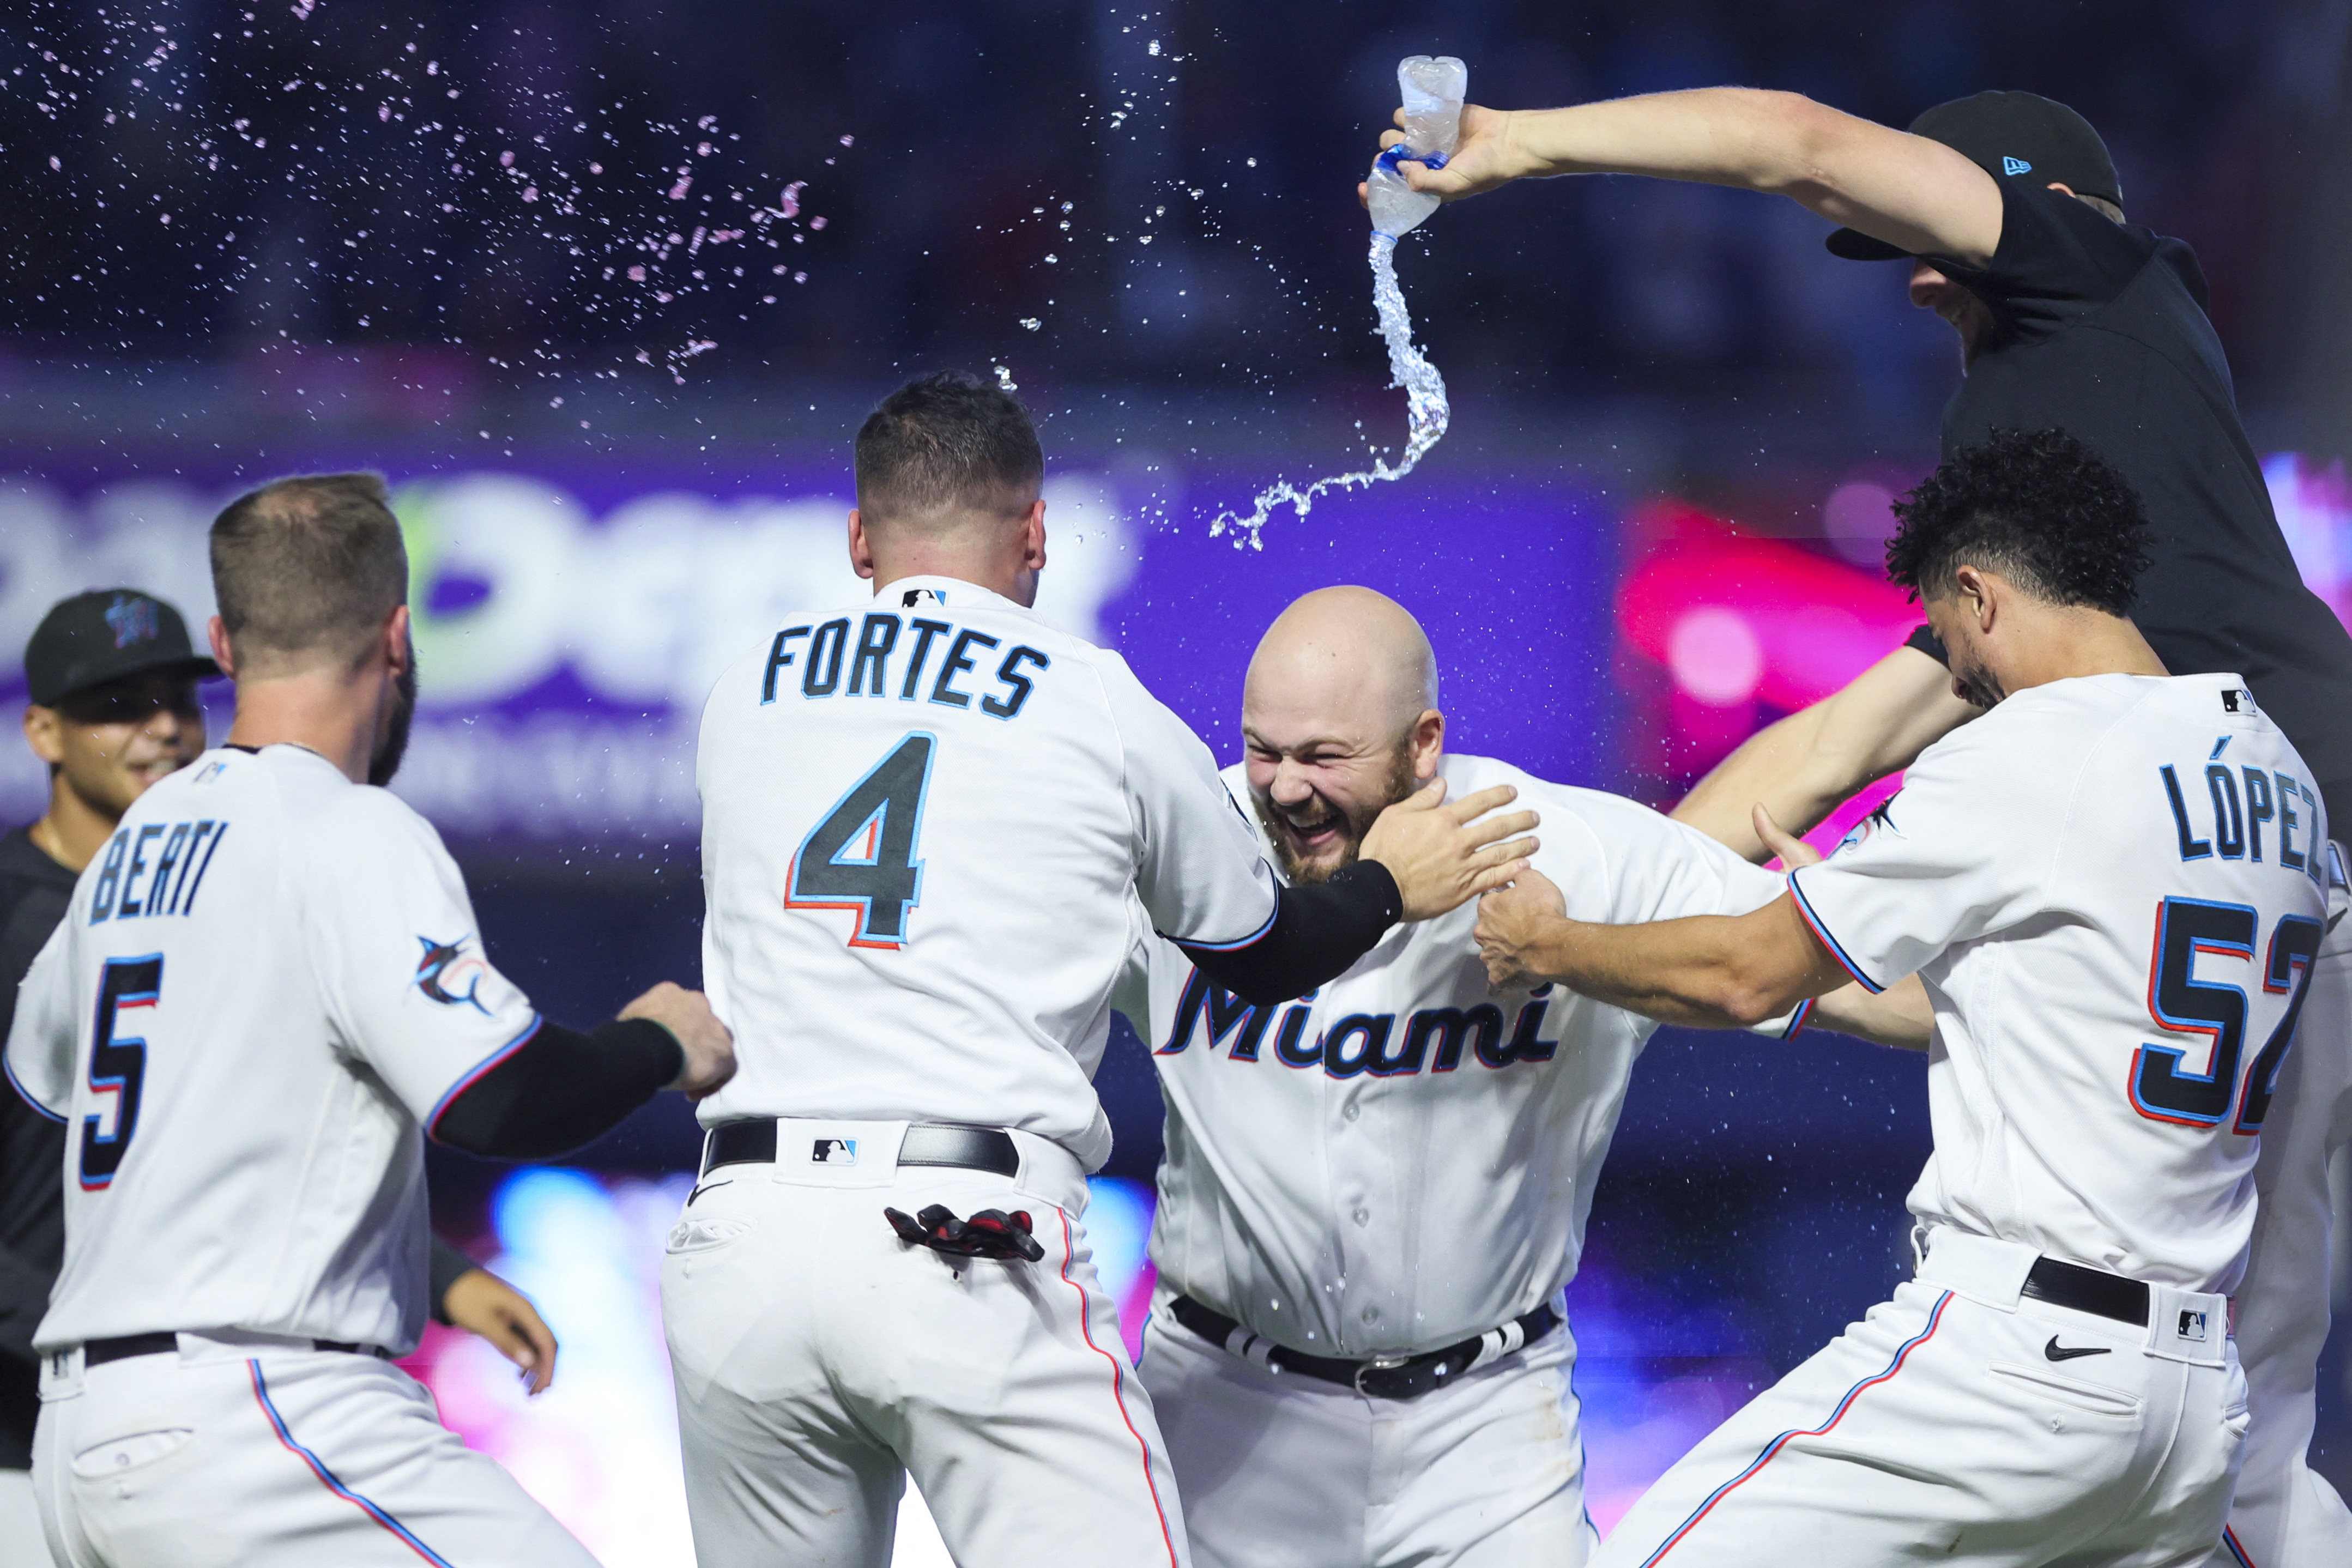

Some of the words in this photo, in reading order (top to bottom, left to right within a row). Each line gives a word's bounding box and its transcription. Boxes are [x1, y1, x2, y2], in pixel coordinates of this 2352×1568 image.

[761, 613, 1050, 721] FORTES
[89, 820, 228, 925] BERTI
[784, 731, 937, 949] 4
[2160, 736, 2322, 885] LÓPEZ
[80, 953, 164, 1191] 5
[1152, 966, 1557, 1079] Miami
[2128, 895, 2325, 1135] 52
